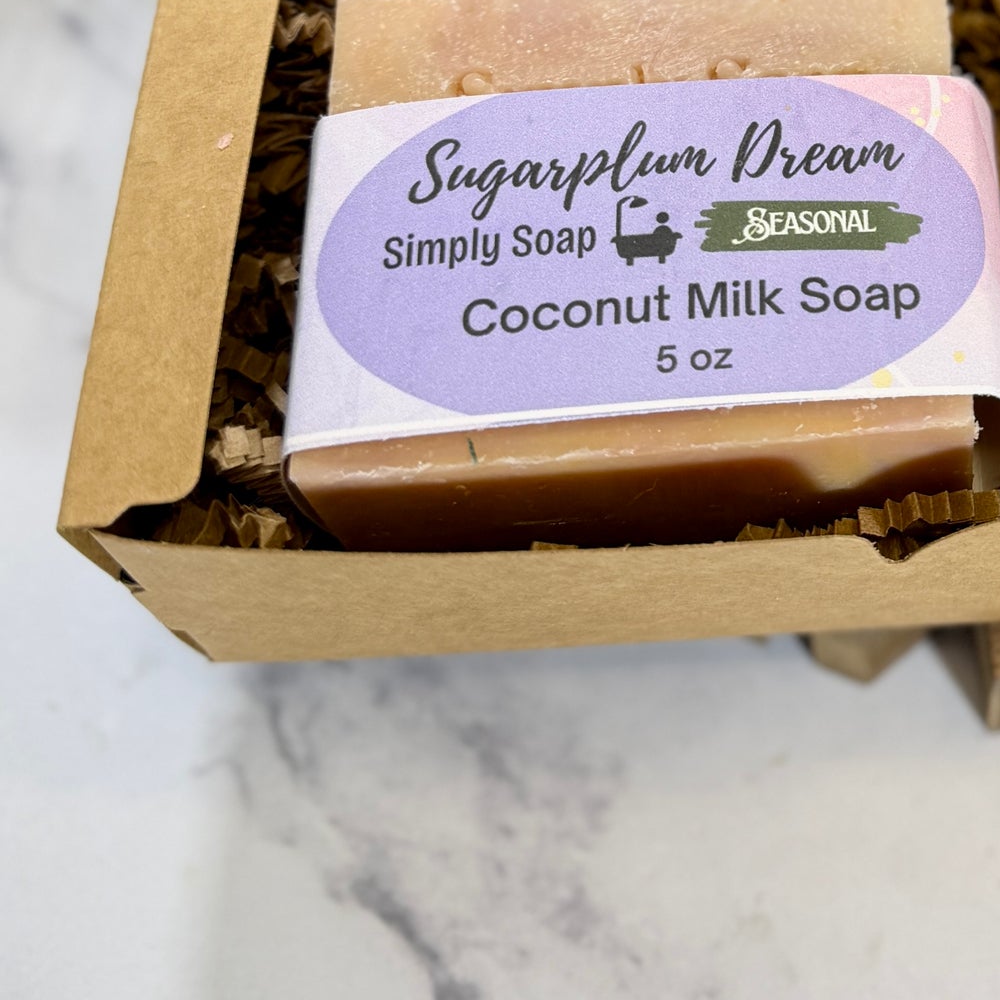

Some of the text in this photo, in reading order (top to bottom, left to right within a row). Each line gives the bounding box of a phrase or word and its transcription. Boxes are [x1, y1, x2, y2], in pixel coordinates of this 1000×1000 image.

[408, 118, 905, 221] Sugarplum Dream
[383, 225, 597, 270] Simply Soap
[462, 276, 921, 337] Coconut Milk Soap
[656, 345, 733, 373] 5 oz
